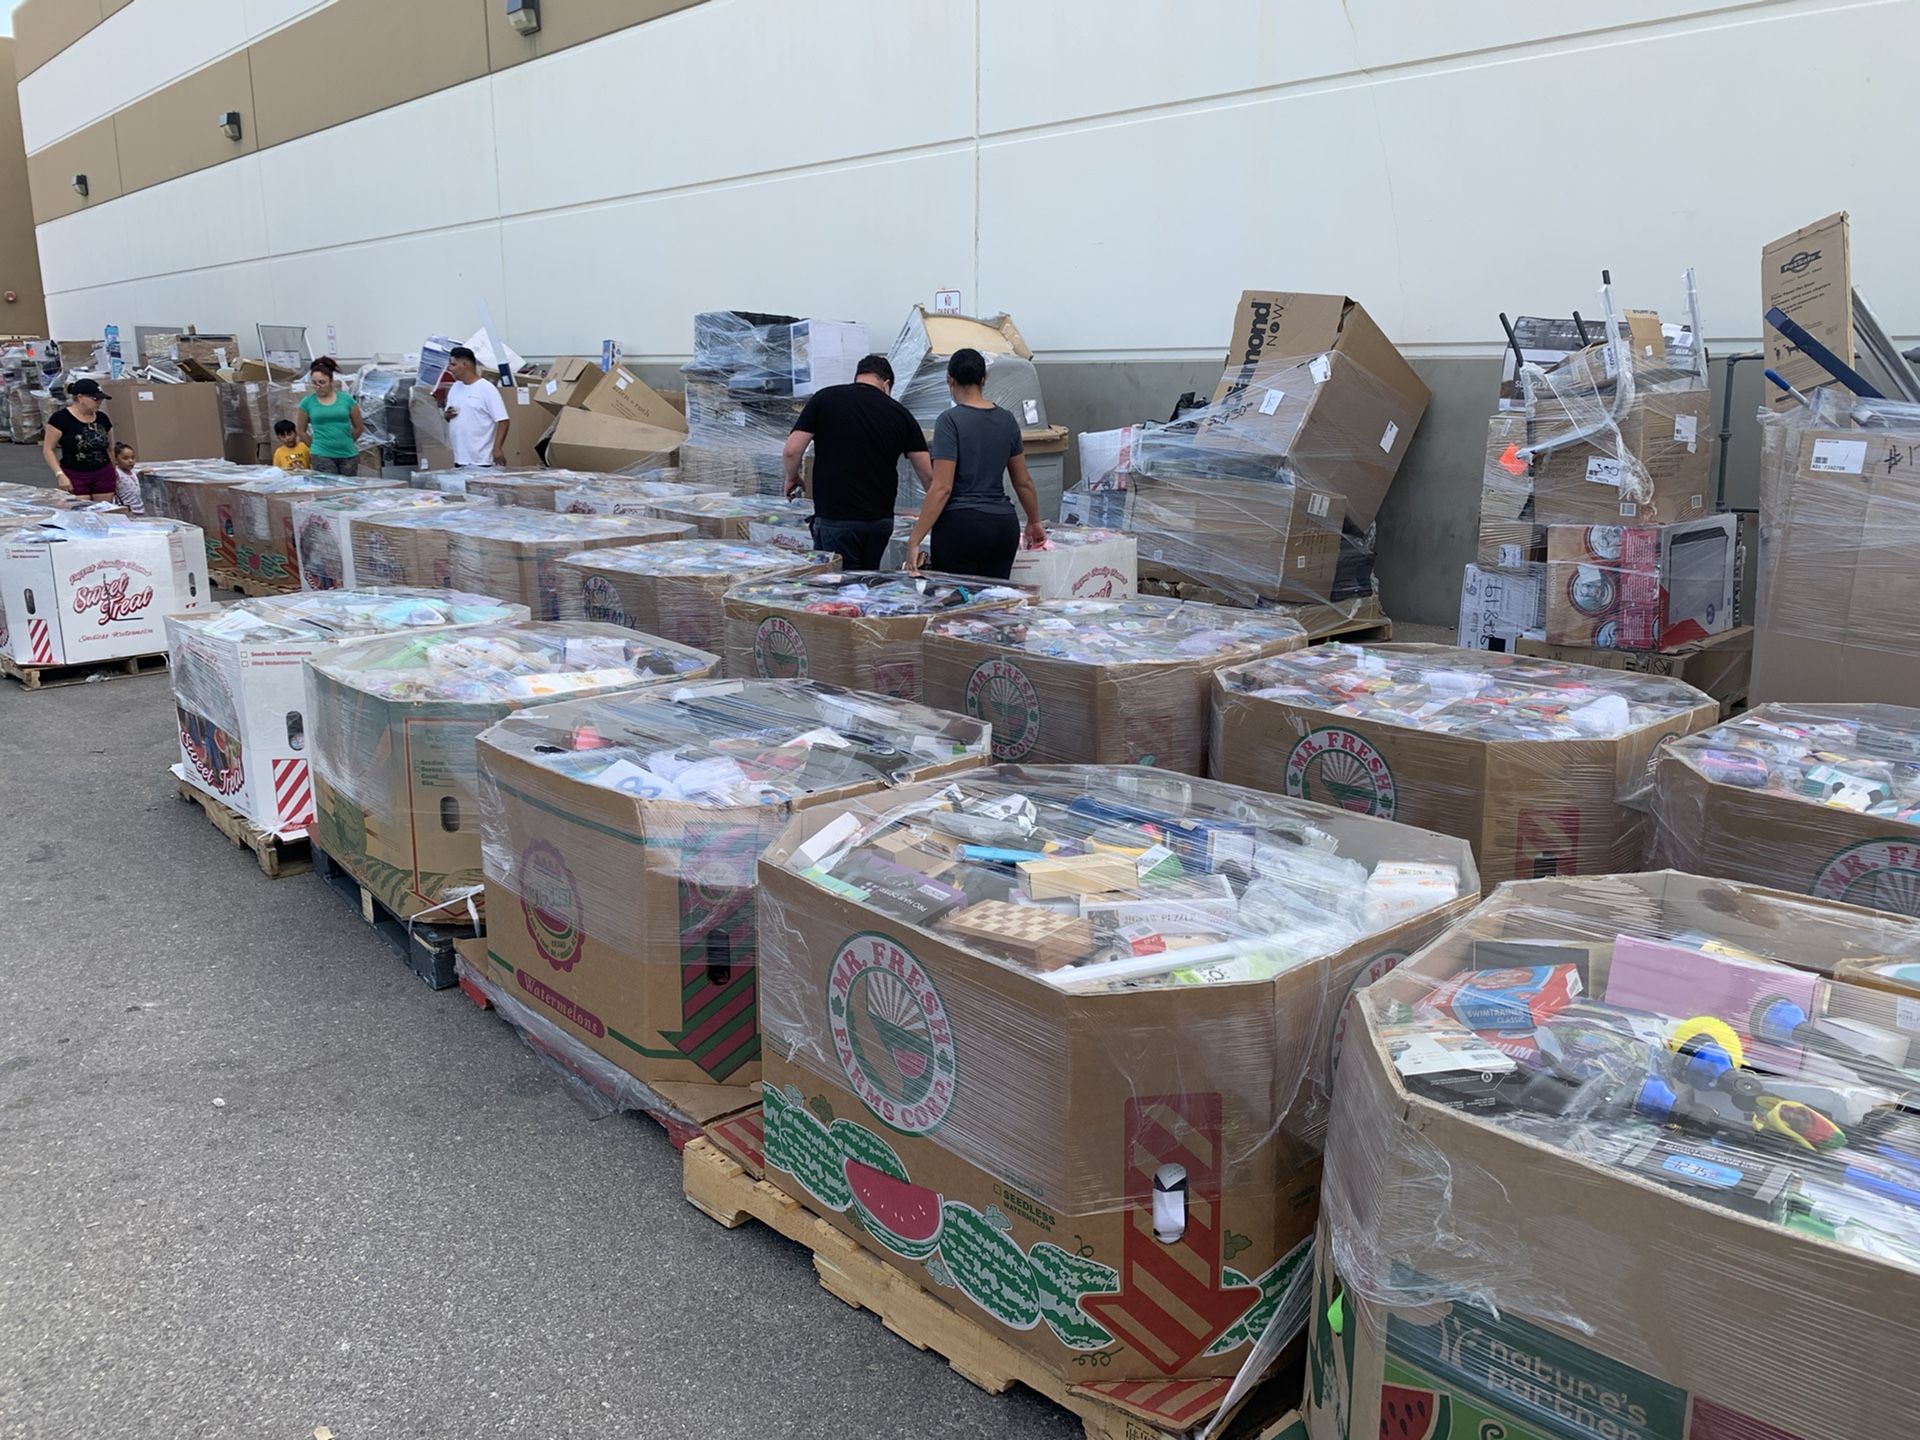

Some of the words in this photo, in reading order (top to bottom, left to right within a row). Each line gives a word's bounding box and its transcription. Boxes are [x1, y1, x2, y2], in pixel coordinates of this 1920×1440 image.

[1266, 303, 1284, 347] NOW
[73, 572, 129, 614] Sweet
[98, 585, 154, 626] Treat
[992, 662, 1037, 708] FRESH
[180, 730, 215, 787] Sweet
[218, 753, 246, 796] Treat
[1290, 739, 1323, 772] MR.
[1326, 731, 1392, 791] FRESH
[1820, 854, 1879, 897] MR.
[1161, 913, 1197, 923] PUZZLE
[523, 973, 599, 1035] Watermelons
[832, 949, 867, 998] MR.
[872, 941, 951, 1047] FRESH
[1467, 1008, 1526, 1018] SWIMTRAINER
[834, 1027, 895, 1122] FARMS
[901, 1079, 952, 1129] CORP.
[1003, 1190, 1056, 1226] SEEDLESS
[1003, 1199, 1052, 1233] WATERMELON
[1487, 1365, 1643, 1440] partner
[1489, 1337, 1648, 1427] nature's
